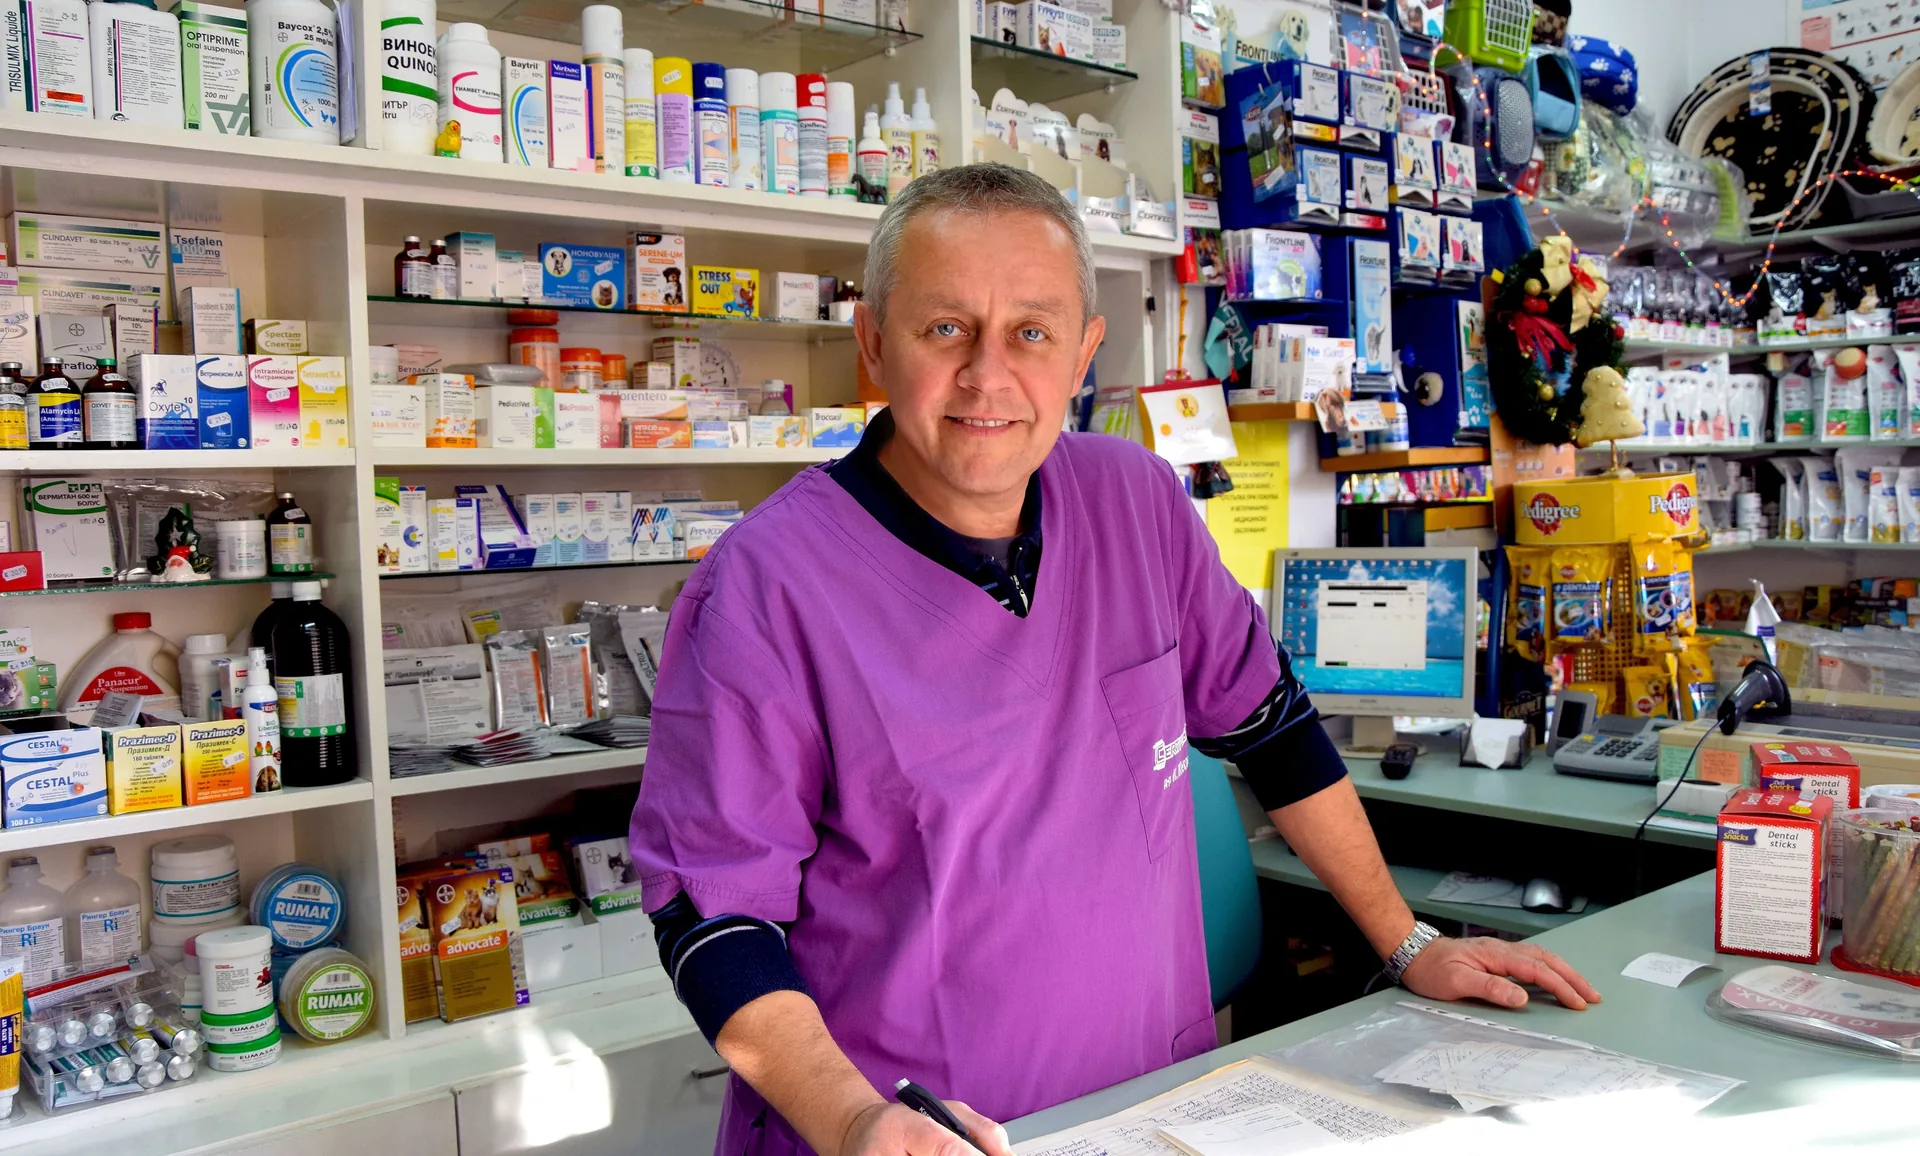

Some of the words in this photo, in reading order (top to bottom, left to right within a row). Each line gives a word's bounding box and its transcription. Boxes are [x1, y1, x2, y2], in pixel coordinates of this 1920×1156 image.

[4, 10, 22, 43] Liquide
[278, 21, 313, 33] Baycox
[187, 31, 241, 47] OPTIPRIME
[204, 44, 245, 56] suspension
[380, 37, 437, 59] ВИНОЕК
[6, 44, 22, 92] TRISULMIX
[511, 60, 539, 70] Baytril
[553, 63, 579, 74] Virbac
[219, 92, 228, 100] ml
[317, 98, 332, 107] 1000
[42, 233, 82, 243] CLINDAVET
[174, 235, 223, 247] Tsefalen
[1265, 233, 1306, 247] FRONTLINE
[639, 248, 683, 258] SERENE-UM
[698, 270, 731, 282] STRESS
[700, 283, 720, 294] OUT
[42, 290, 84, 299] CLINDAVET
[41, 408, 73, 416] Alamycin
[149, 402, 184, 414] Oxytet
[1521, 502, 1580, 524] Pedigree
[97, 677, 139, 687] Panacur
[109, 684, 149, 694] Suspension
[190, 725, 245, 740] Prazimec-C
[28, 740, 61, 749] CESTAL
[118, 733, 176, 747] Prazimec-D
[196, 738, 236, 749] Празимек-С
[127, 745, 170, 755] Празимек-Д
[26, 776, 74, 790] CESTAL
[1811, 779, 1840, 789] Dental
[1812, 787, 1839, 797] sticks
[11, 819, 23, 827] 100
[1723, 833, 1749, 842] Snacks
[1768, 830, 1799, 841] Dental
[1770, 840, 1797, 850] sticks
[82, 912, 107, 920] Рингер
[109, 908, 129, 917] Браун
[275, 901, 331, 920] RUMAK
[520, 904, 571, 921] dvantage
[27, 922, 50, 931] Браун
[103, 918, 119, 933] Ri
[21, 933, 37, 947] Ri
[447, 935, 501, 955] advocate
[307, 992, 365, 1010] RUMAK
[516, 992, 522, 1002] 3
